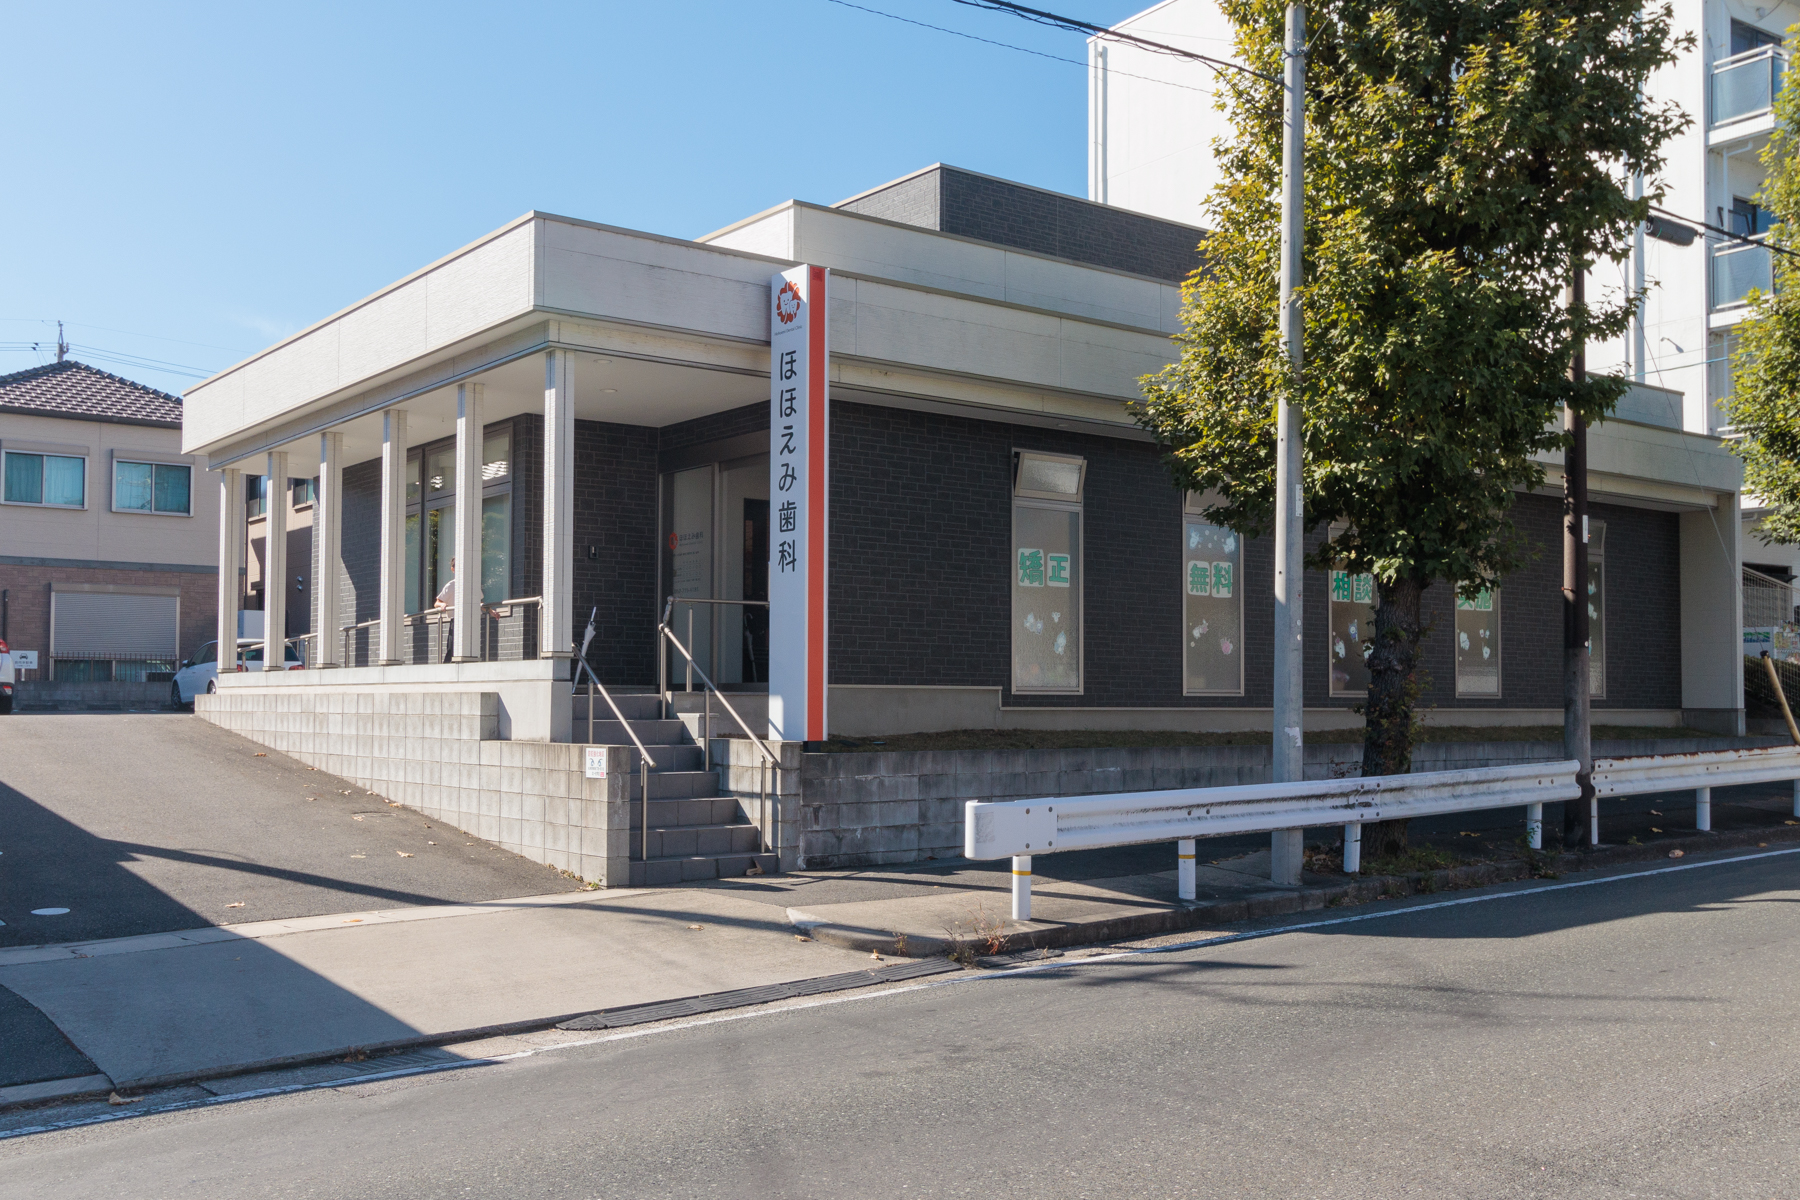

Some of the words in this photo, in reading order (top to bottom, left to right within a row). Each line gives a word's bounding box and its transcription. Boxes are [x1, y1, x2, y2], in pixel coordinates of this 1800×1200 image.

[778, 350, 797, 574] ほほえみ歯科
[1019, 550, 1069, 586] 矯正
[1190, 563, 1232, 594] 無料
[1332, 571, 1372, 601] 相談
